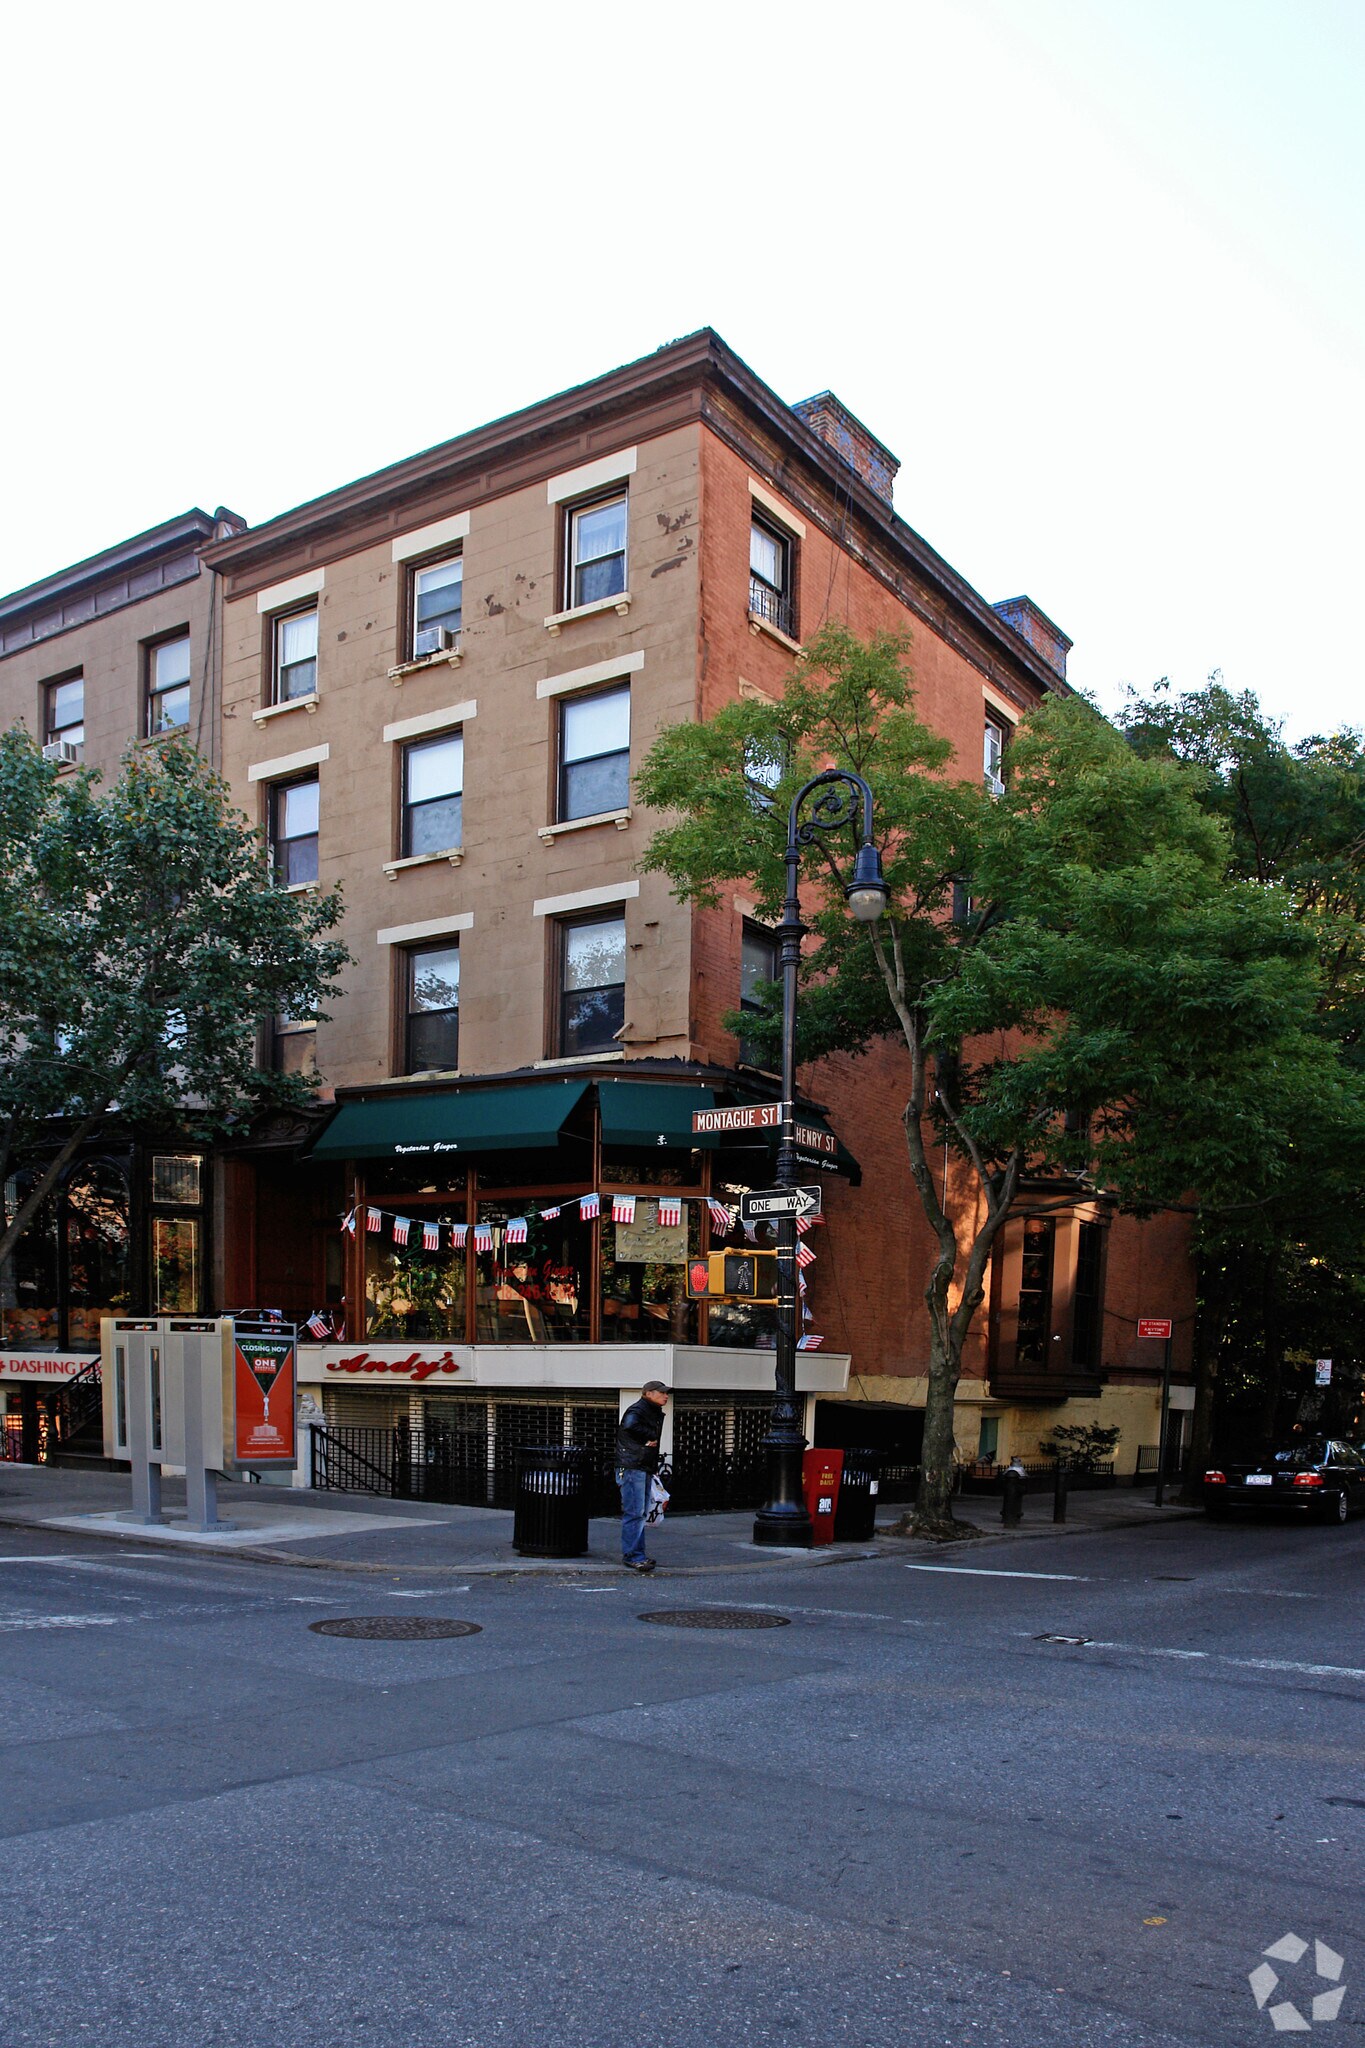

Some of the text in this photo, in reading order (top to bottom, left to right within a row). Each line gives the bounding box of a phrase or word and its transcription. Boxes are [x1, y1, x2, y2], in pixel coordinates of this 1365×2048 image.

[697, 1108, 775, 1130] MONTAGUE ST
[795, 1126, 835, 1152] HENRY ST
[394, 1142, 458, 1154] Vegetarian Ginger
[750, 1197, 808, 1212] ONE WAY
[241, 1344, 270, 1352] CLOSING
[9, 1359, 76, 1375] DASHING
[254, 1359, 276, 1367] ONE
[326, 1351, 459, 1381] Andy's
